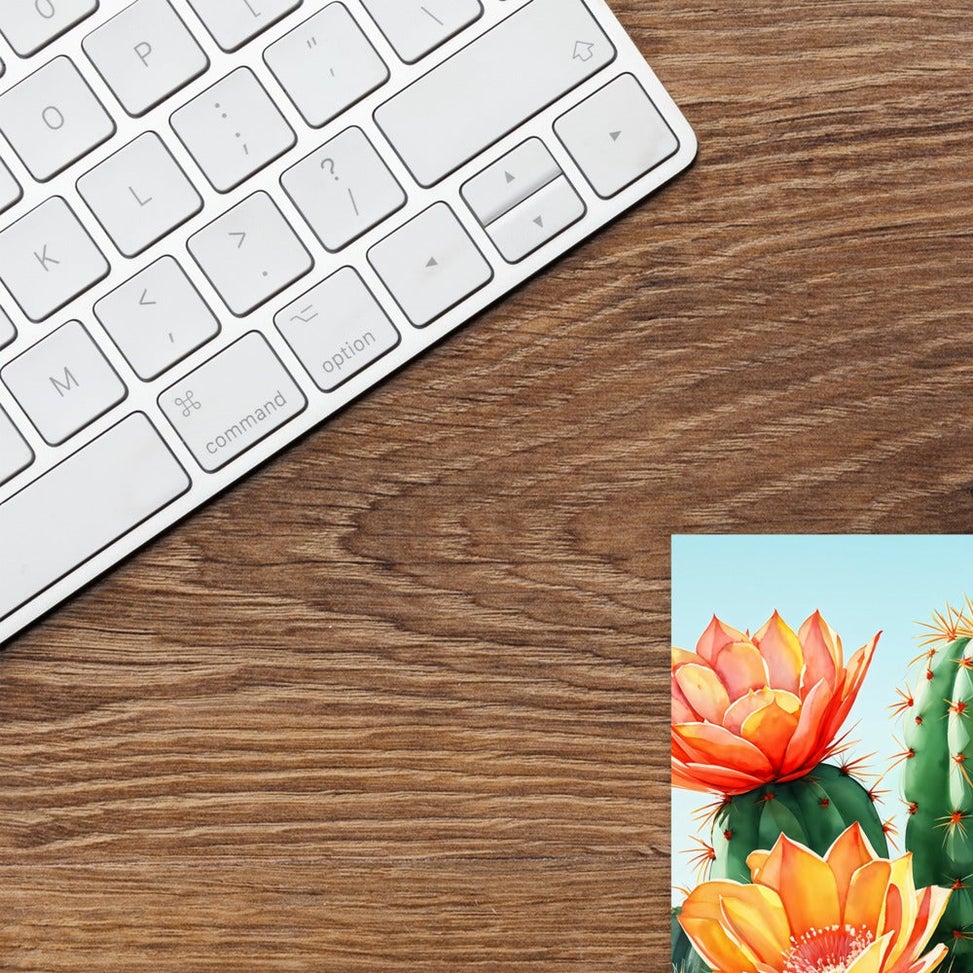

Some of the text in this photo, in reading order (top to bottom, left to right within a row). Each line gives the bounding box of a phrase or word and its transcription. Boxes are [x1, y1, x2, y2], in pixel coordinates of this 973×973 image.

[133, 41, 152, 68] P
[41, 105, 65, 130] O
[320, 157, 340, 182] ?
[128, 185, 153, 207] L
[33, 244, 61, 273] K
[322, 331, 376, 373] option
[48, 366, 80, 398] M
[205, 390, 288, 454] command
